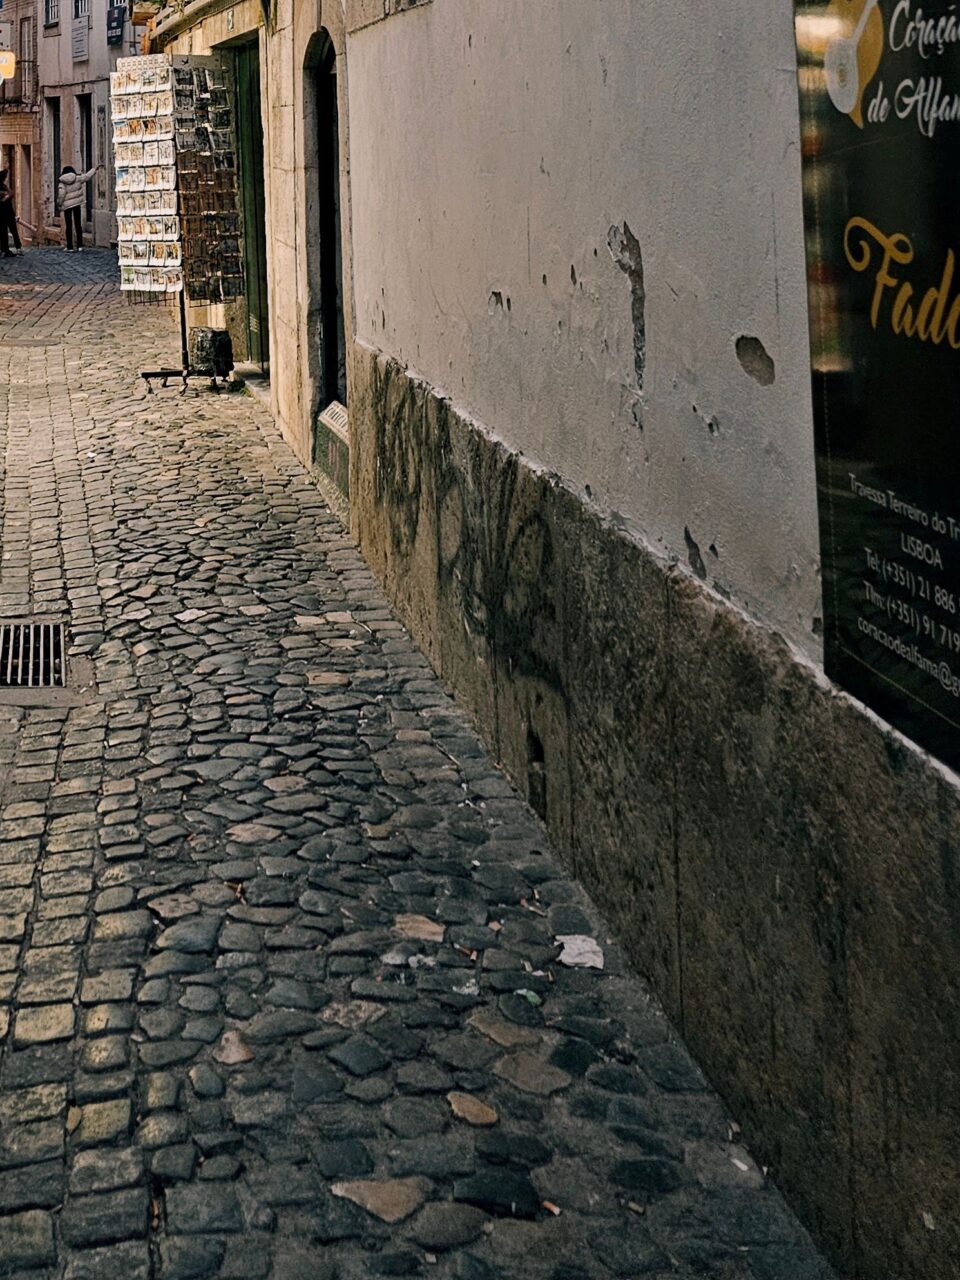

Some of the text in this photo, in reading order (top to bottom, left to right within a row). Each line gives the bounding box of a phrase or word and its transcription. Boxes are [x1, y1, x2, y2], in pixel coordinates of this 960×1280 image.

[868, 81, 890, 122] de
[848, 472, 886, 507] Travessa
[886, 489, 929, 526] Terreiro
[931, 511, 947, 534] do
[900, 531, 944, 570] LISBOA
[882, 559, 915, 597] (+351)
[917, 576, 930, 600] 21
[935, 585, 955, 614] 886
[886, 595, 920, 636] (+351)
[923, 615, 935, 639] 91
[858, 616, 960, 697] coracaodealfama@g
